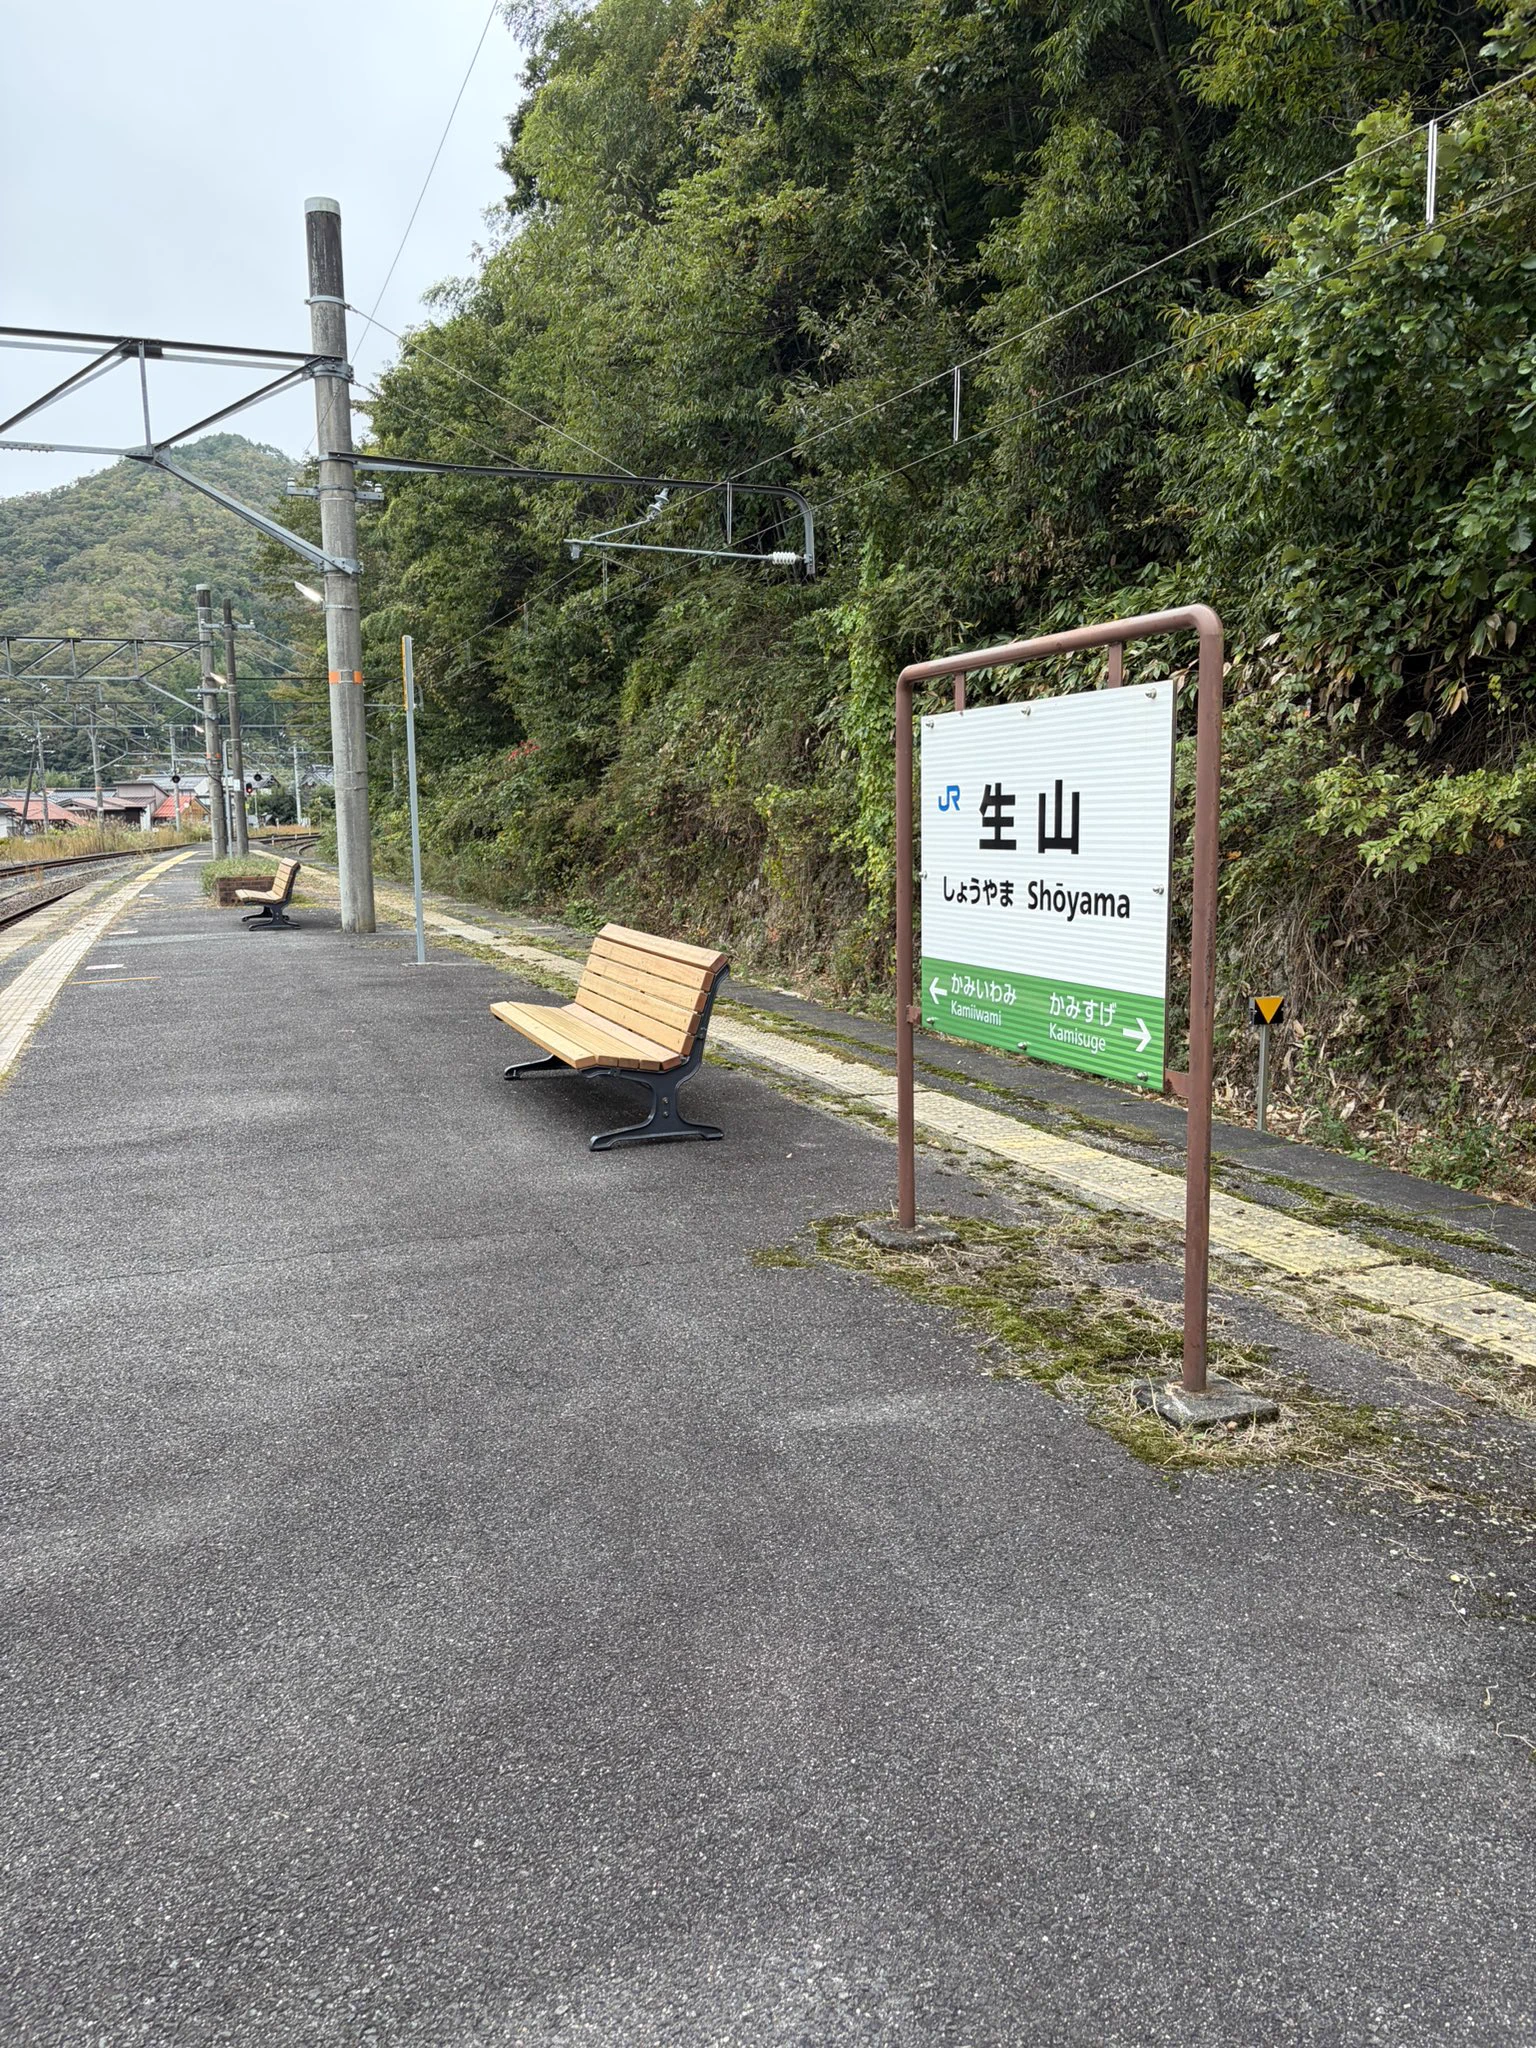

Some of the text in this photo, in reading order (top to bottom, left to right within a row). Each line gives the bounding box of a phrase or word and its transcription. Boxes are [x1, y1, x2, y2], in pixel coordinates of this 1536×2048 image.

[938, 785, 961, 811] JR
[979, 779, 1081, 855] 生山
[943, 876, 1130, 921] しょうやま Shōyama
[951, 973, 1017, 1006] かみいわみ
[951, 1000, 1001, 1026] Kamiiwami
[1049, 992, 1117, 1027] かみすげ
[1049, 1023, 1106, 1054] Kamisuge
